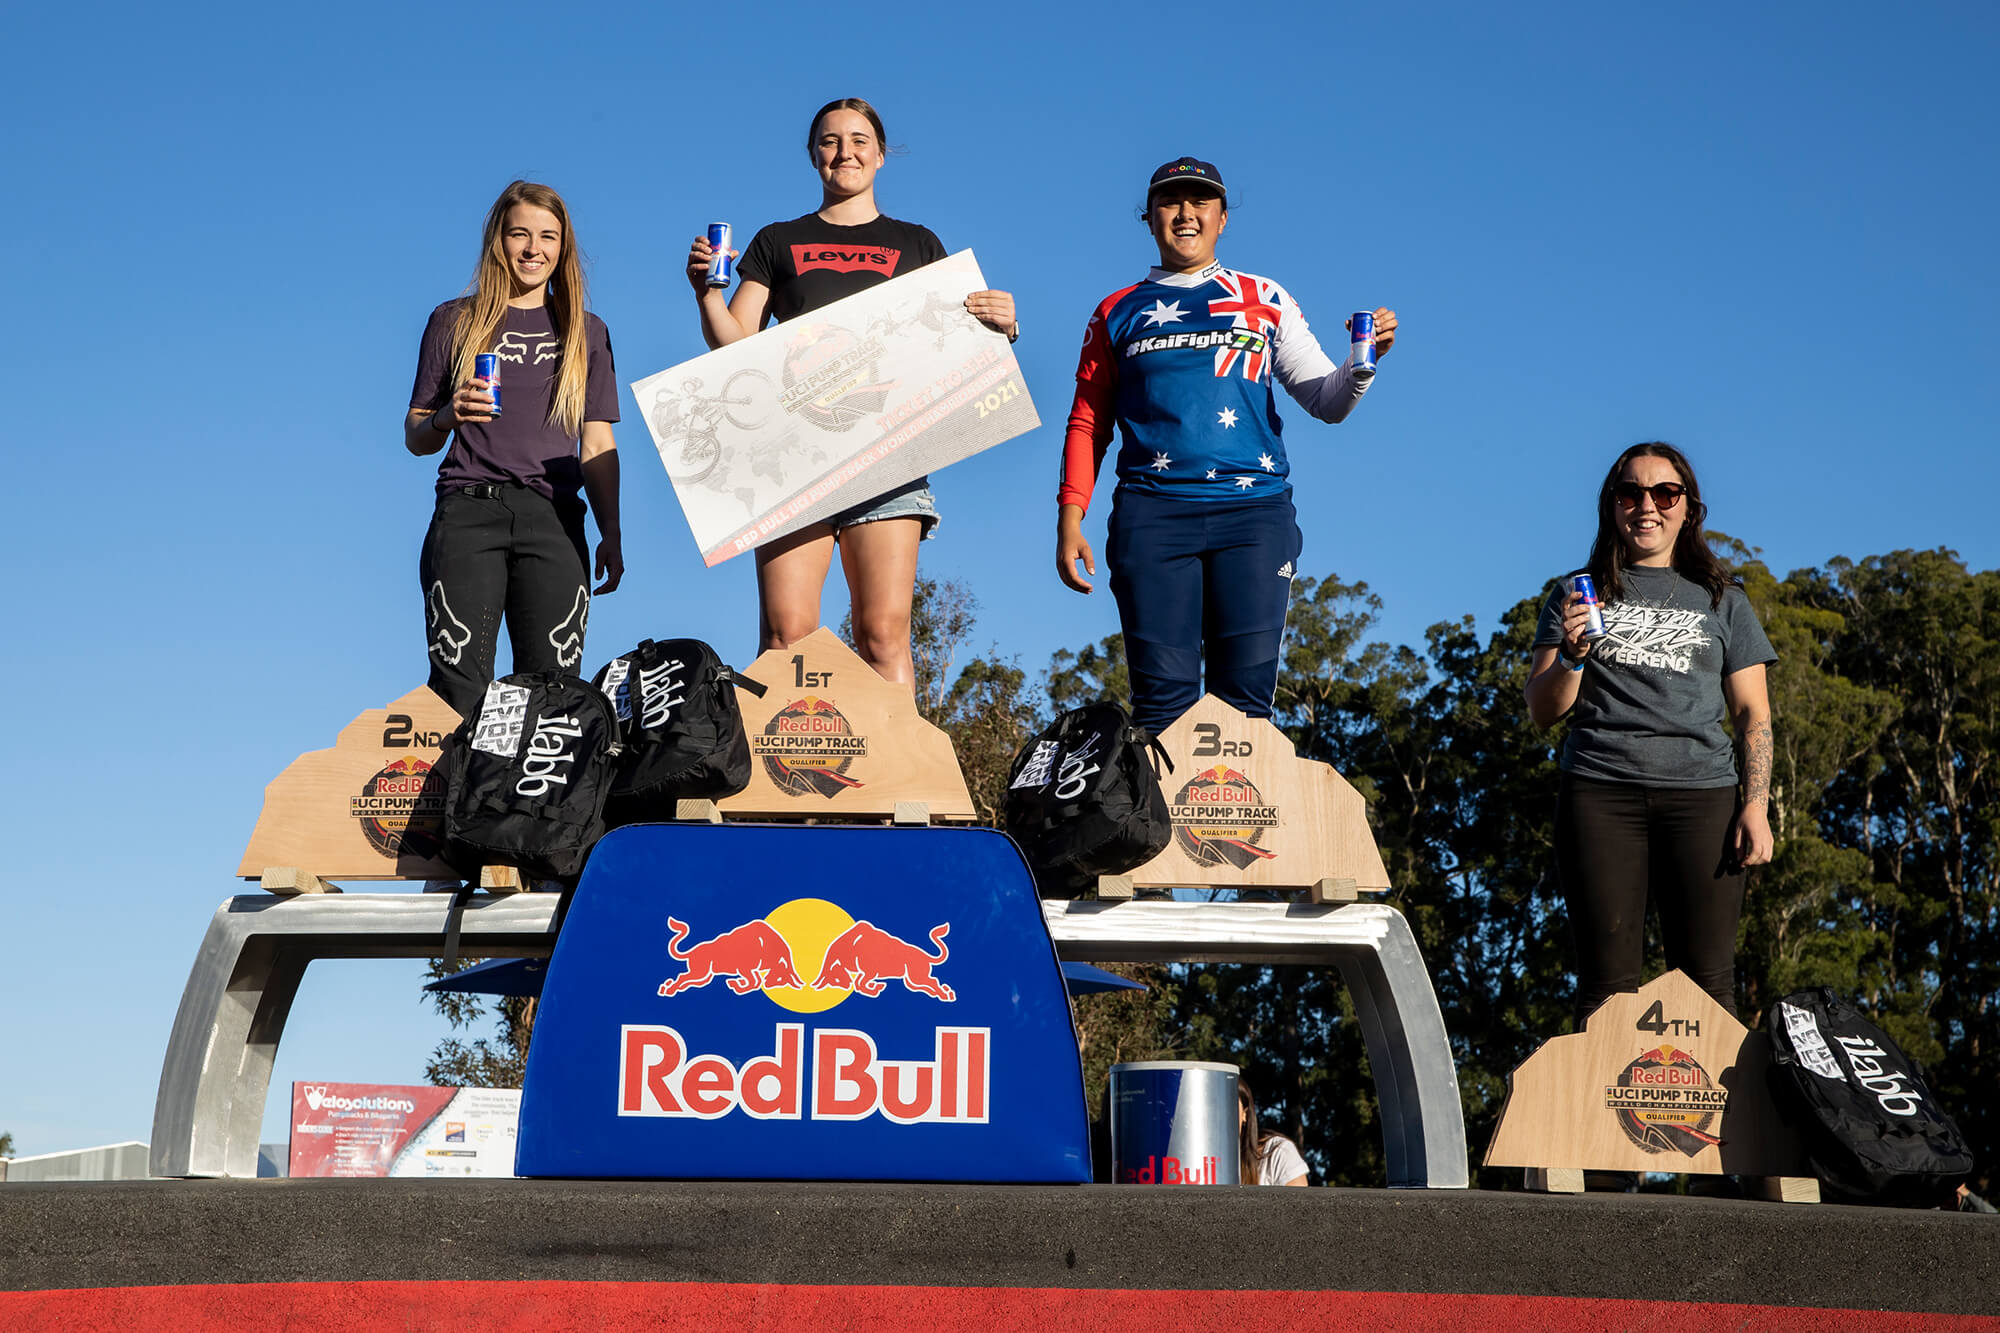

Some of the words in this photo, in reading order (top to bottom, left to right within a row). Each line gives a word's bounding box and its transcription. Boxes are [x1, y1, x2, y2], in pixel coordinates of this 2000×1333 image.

[875, 386, 935, 433] TICKET
[936, 370, 963, 394] TO
[963, 347, 1000, 375] THE
[974, 380, 1021, 418] 2021
[734, 530, 759, 551] RED
[760, 510, 789, 535] BULL
[877, 421, 918, 457] WORLD
[791, 654, 833, 688] 1ST
[1597, 645, 1690, 674] WEEKEND
[639, 659, 686, 729] ilabb
[383, 714, 443, 748] 2ND
[760, 737, 785, 747] UCI
[787, 737, 823, 748] PUMP
[825, 738, 866, 748] TRACK
[780, 718, 810, 732] Red
[812, 718, 843, 733] Bull
[1192, 723, 1253, 757] 3RD
[516, 714, 583, 796] ilabb
[378, 778, 409, 793] Red
[411, 778, 441, 793] Bull
[1189, 787, 1220, 802] Red
[1222, 788, 1252, 803] Bull
[358, 798, 385, 809] UCI
[385, 798, 422, 809] PUMP
[1170, 807, 1195, 817] UCI
[1197, 807, 1234, 818] PUMP
[1236, 808, 1277, 818] TRACK
[1636, 1000, 1700, 1037] 4TH
[621, 1026, 801, 1118] Red
[814, 1029, 989, 1122] Bull
[1633, 1068, 1666, 1084] Red
[1669, 1069, 1701, 1085] Bull
[1833, 1034, 1922, 1116] ilabb
[1613, 1089, 1639, 1099] UCI
[1641, 1090, 1681, 1101] PUMP
[1683, 1091, 1728, 1102] TRACK
[1162, 1156, 1217, 1184] Bull
